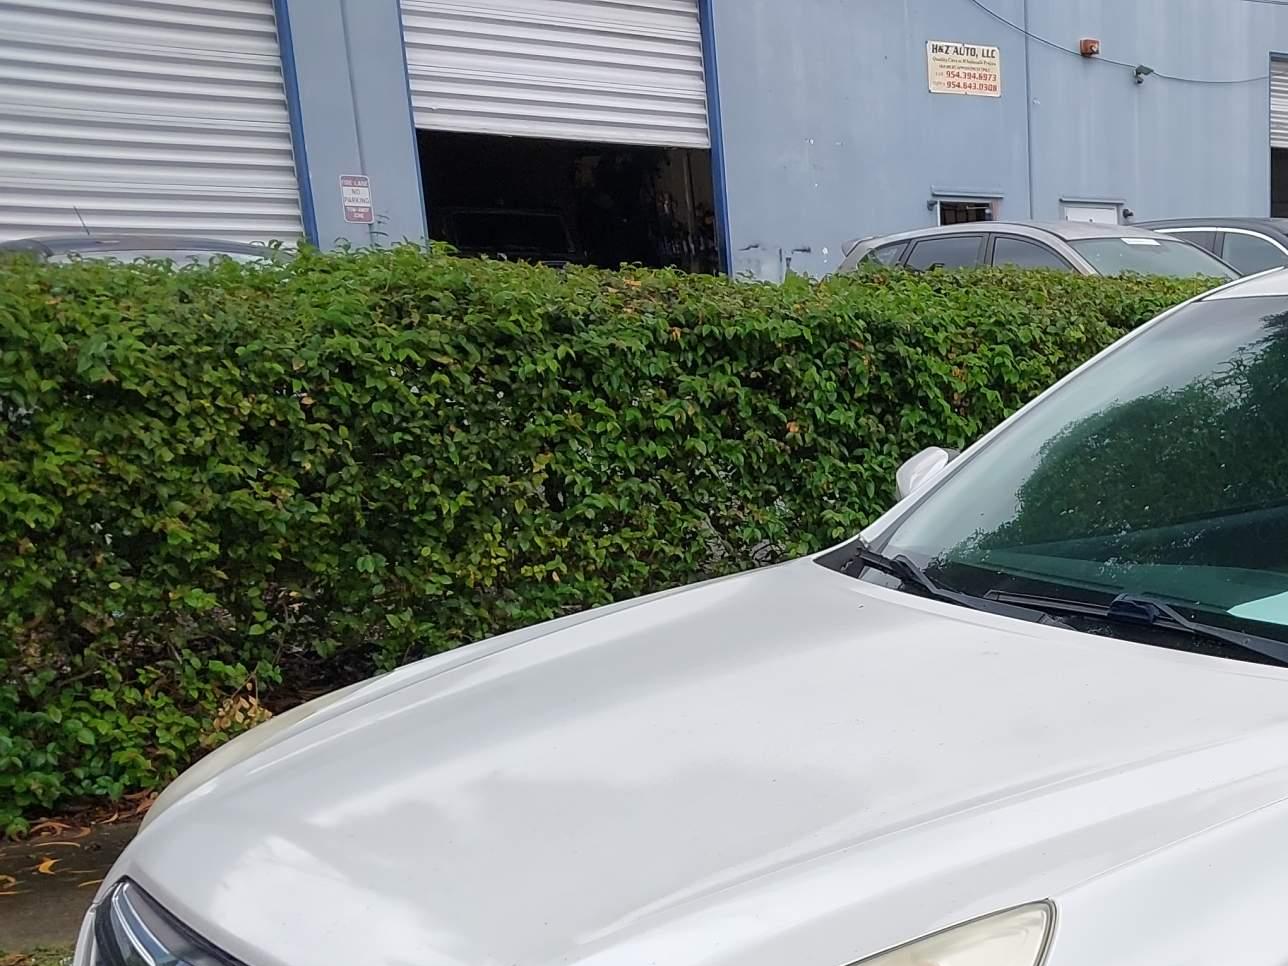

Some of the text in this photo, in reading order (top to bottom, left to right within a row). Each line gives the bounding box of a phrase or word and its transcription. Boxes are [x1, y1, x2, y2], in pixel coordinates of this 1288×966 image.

[932, 44, 996, 58] H&Z AUTO, LLC
